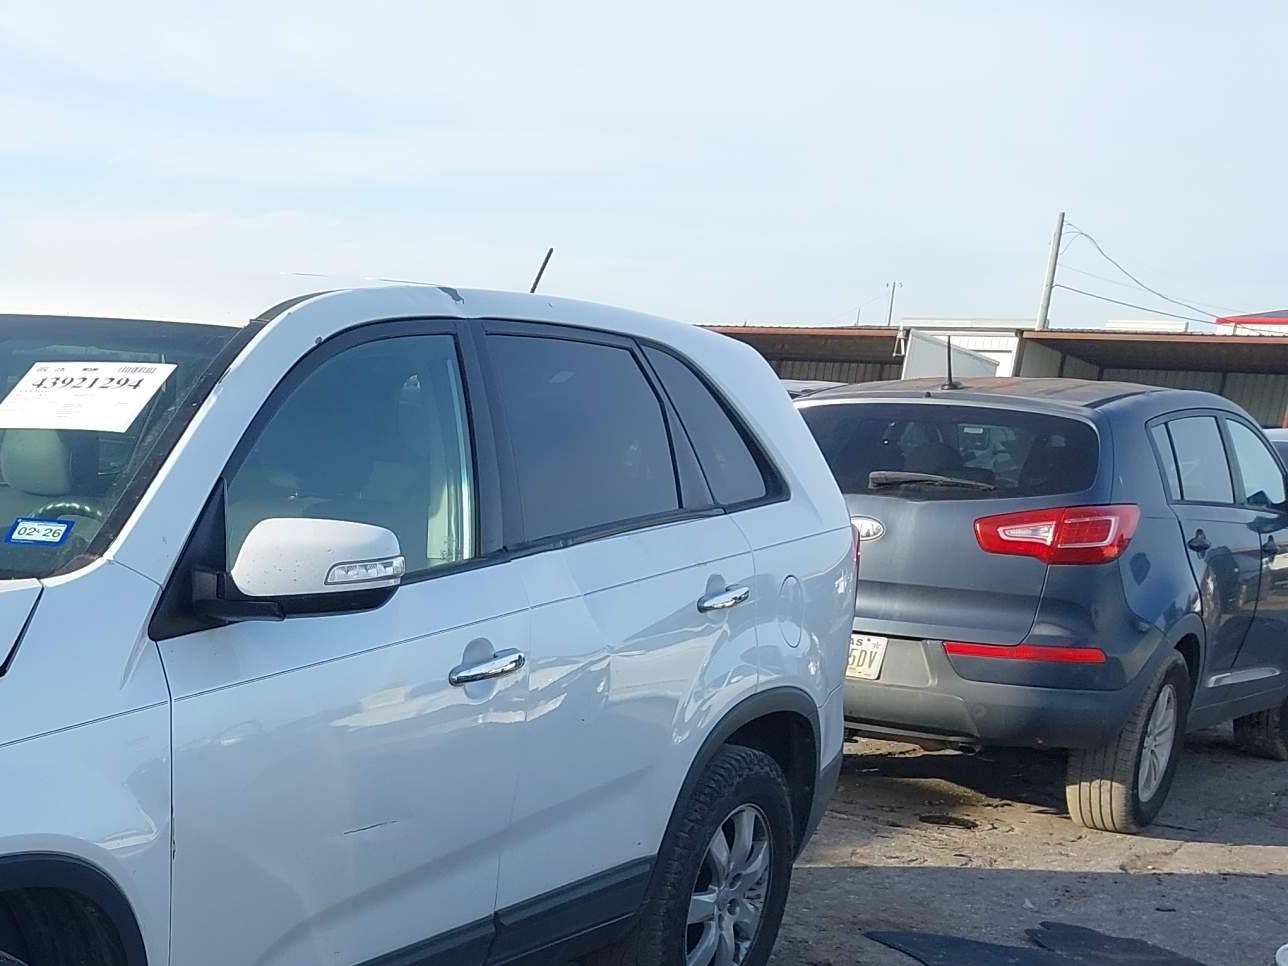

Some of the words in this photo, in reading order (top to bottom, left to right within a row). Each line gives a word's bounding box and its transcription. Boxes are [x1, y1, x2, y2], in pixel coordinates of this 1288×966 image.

[31, 376, 144, 390] 43921294
[17, 526, 36, 537] 02
[42, 527, 62, 538] 26
